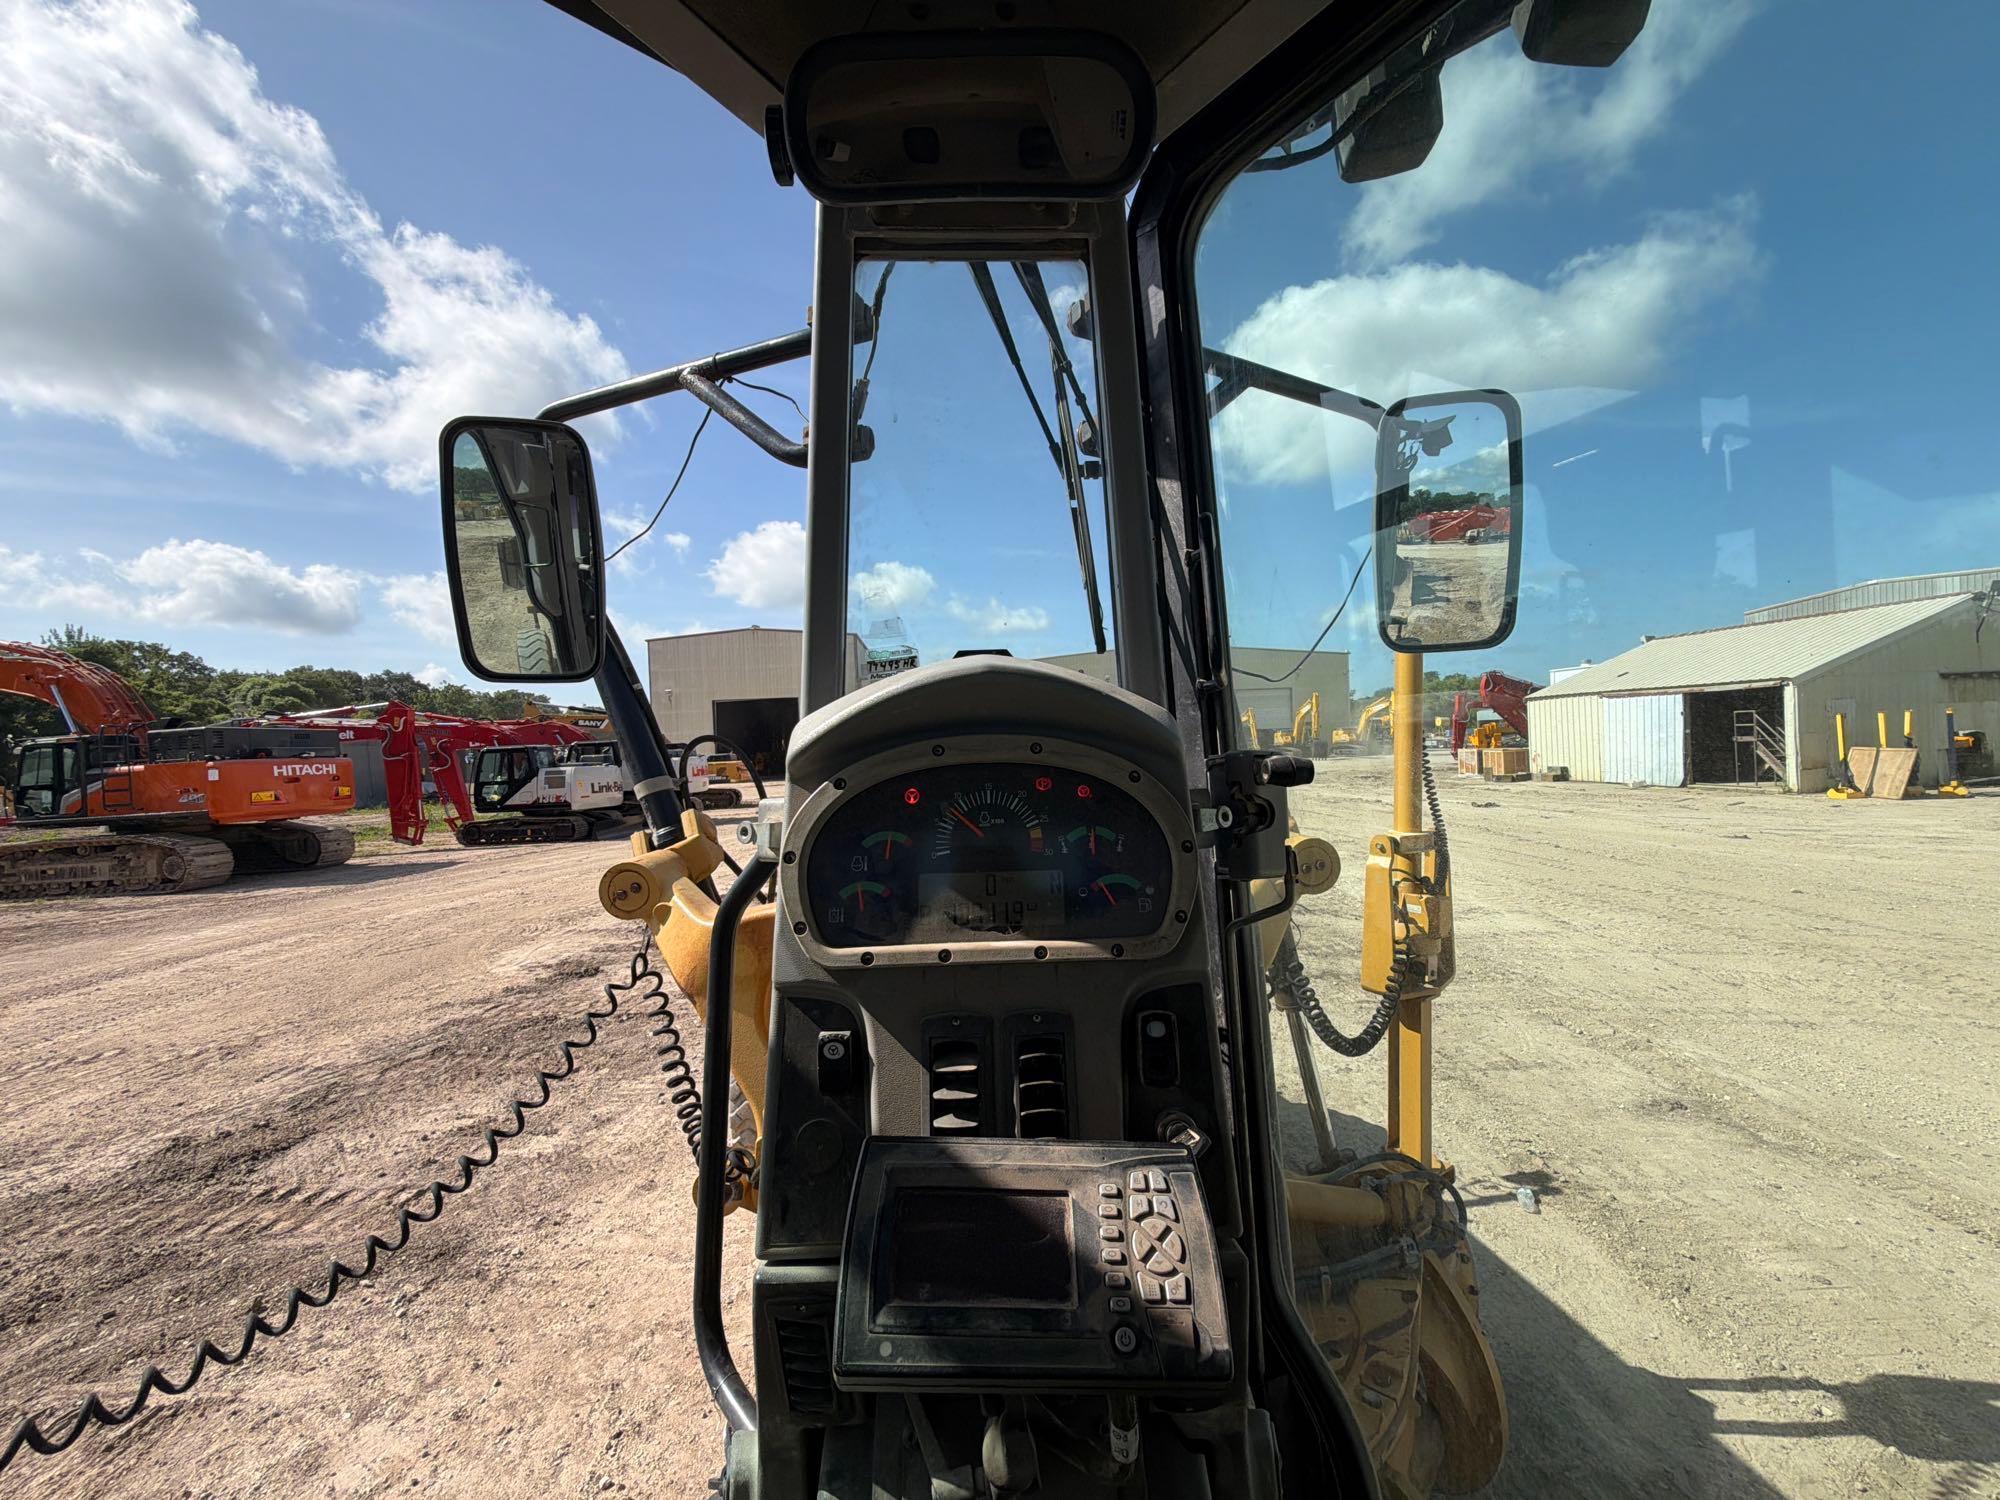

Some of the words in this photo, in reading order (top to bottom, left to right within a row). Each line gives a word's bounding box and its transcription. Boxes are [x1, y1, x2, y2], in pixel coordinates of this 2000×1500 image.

[578, 719, 602, 727] SANY
[273, 763, 337, 777] HITACHI
[1018, 790, 1028, 798] 20
[1040, 815, 1049, 823] 25
[1171, 1282, 1183, 1296] OK
